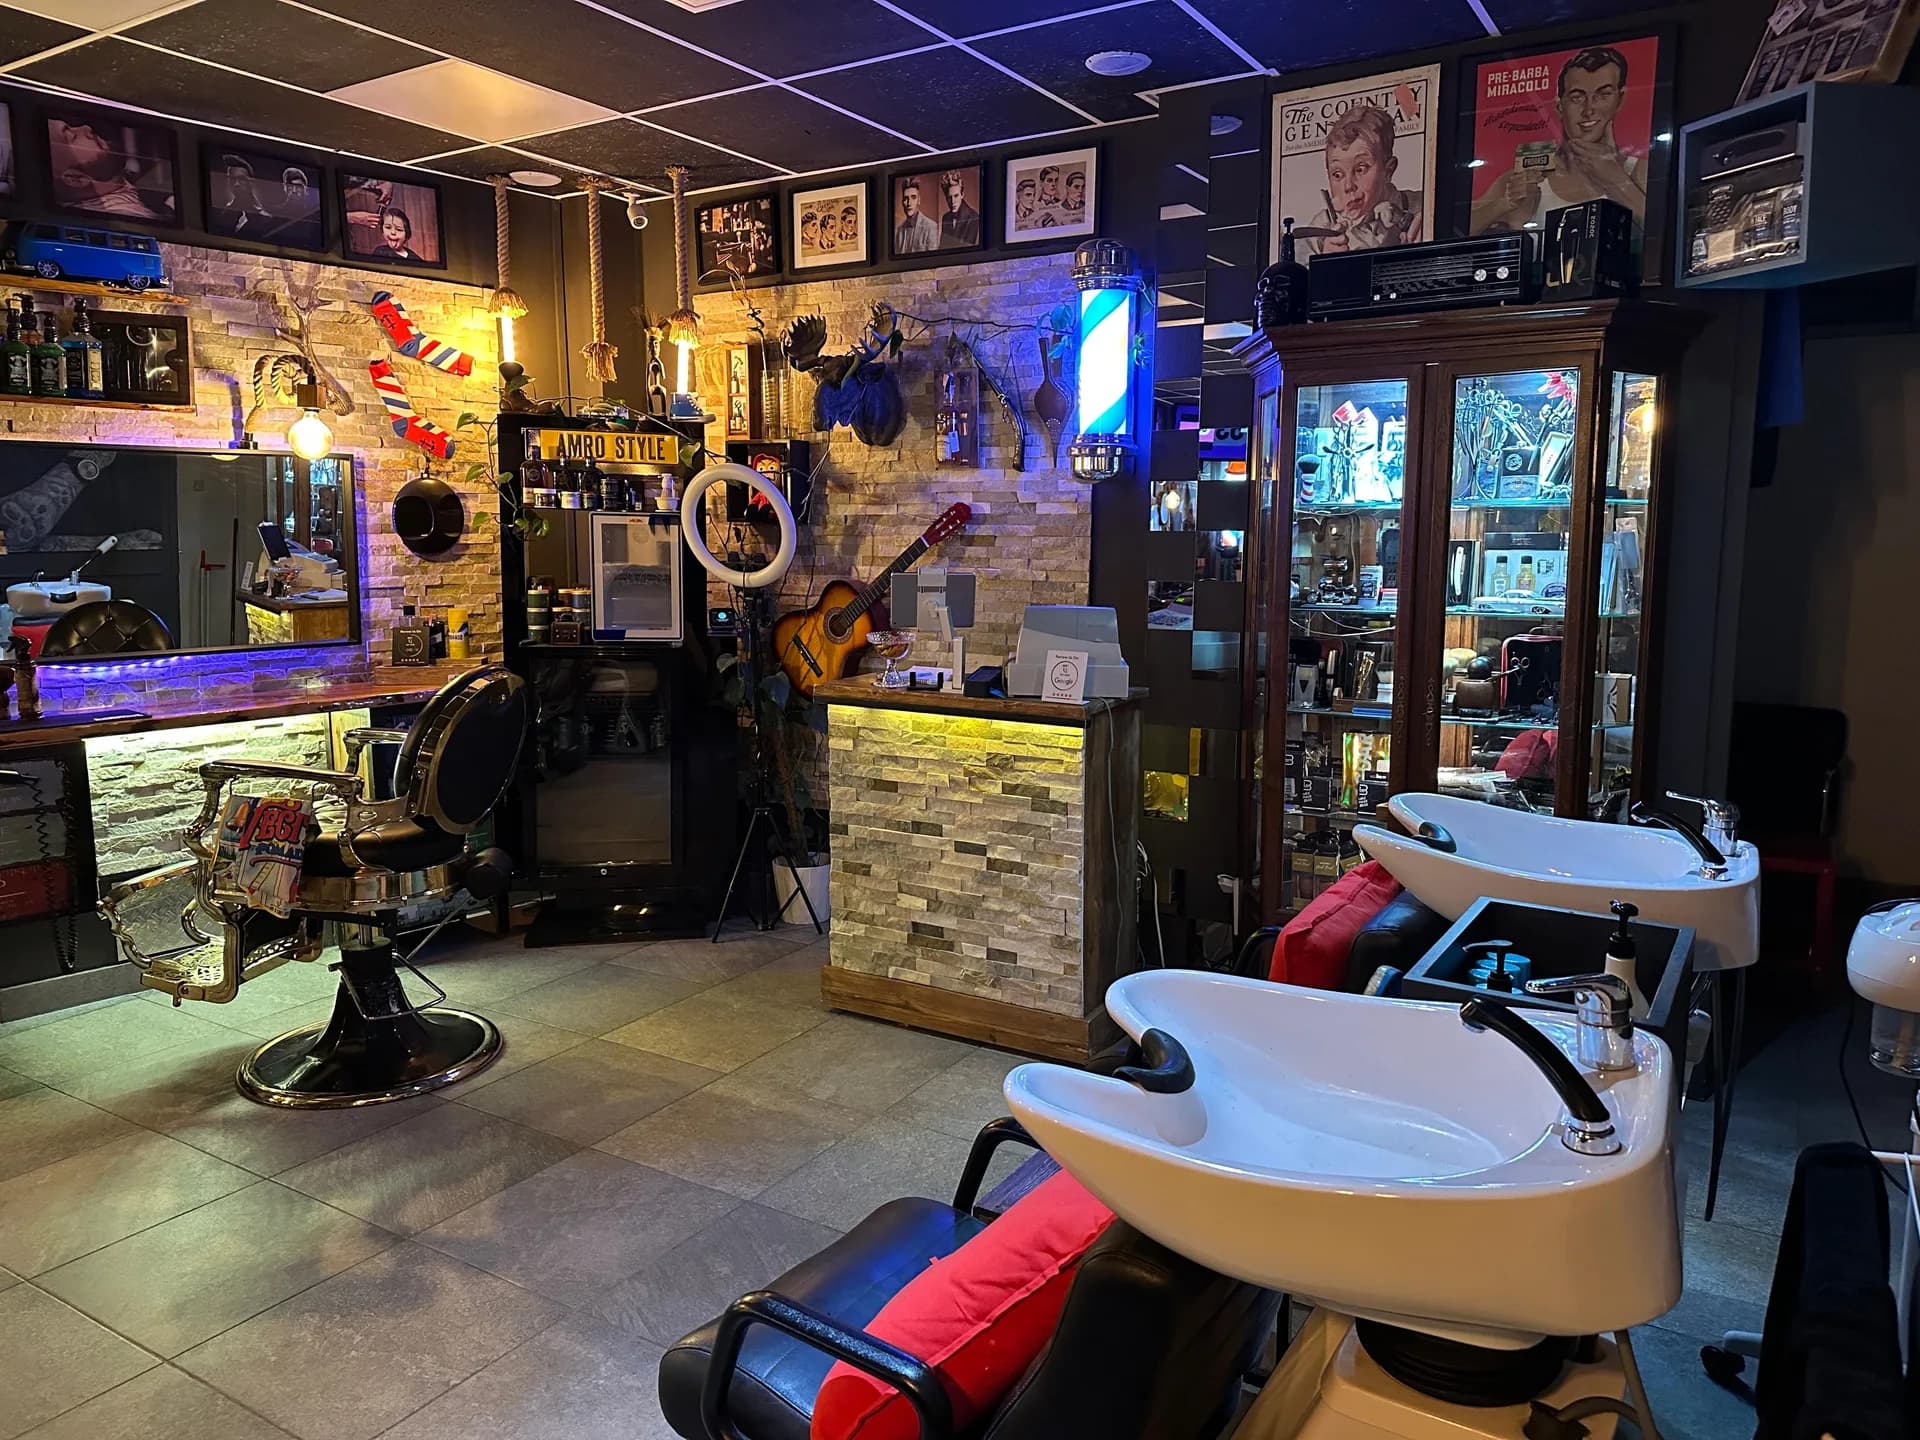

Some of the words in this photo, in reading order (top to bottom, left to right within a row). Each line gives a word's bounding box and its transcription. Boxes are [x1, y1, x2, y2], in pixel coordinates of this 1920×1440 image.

[1487, 65, 1549, 85] PRE-BARBA
[1487, 78, 1549, 98] MIRACOLO
[1285, 106, 1314, 125] The
[1320, 85, 1422, 119] COUNTY
[557, 434, 605, 459] AMRO
[615, 435, 666, 461] STYLE
